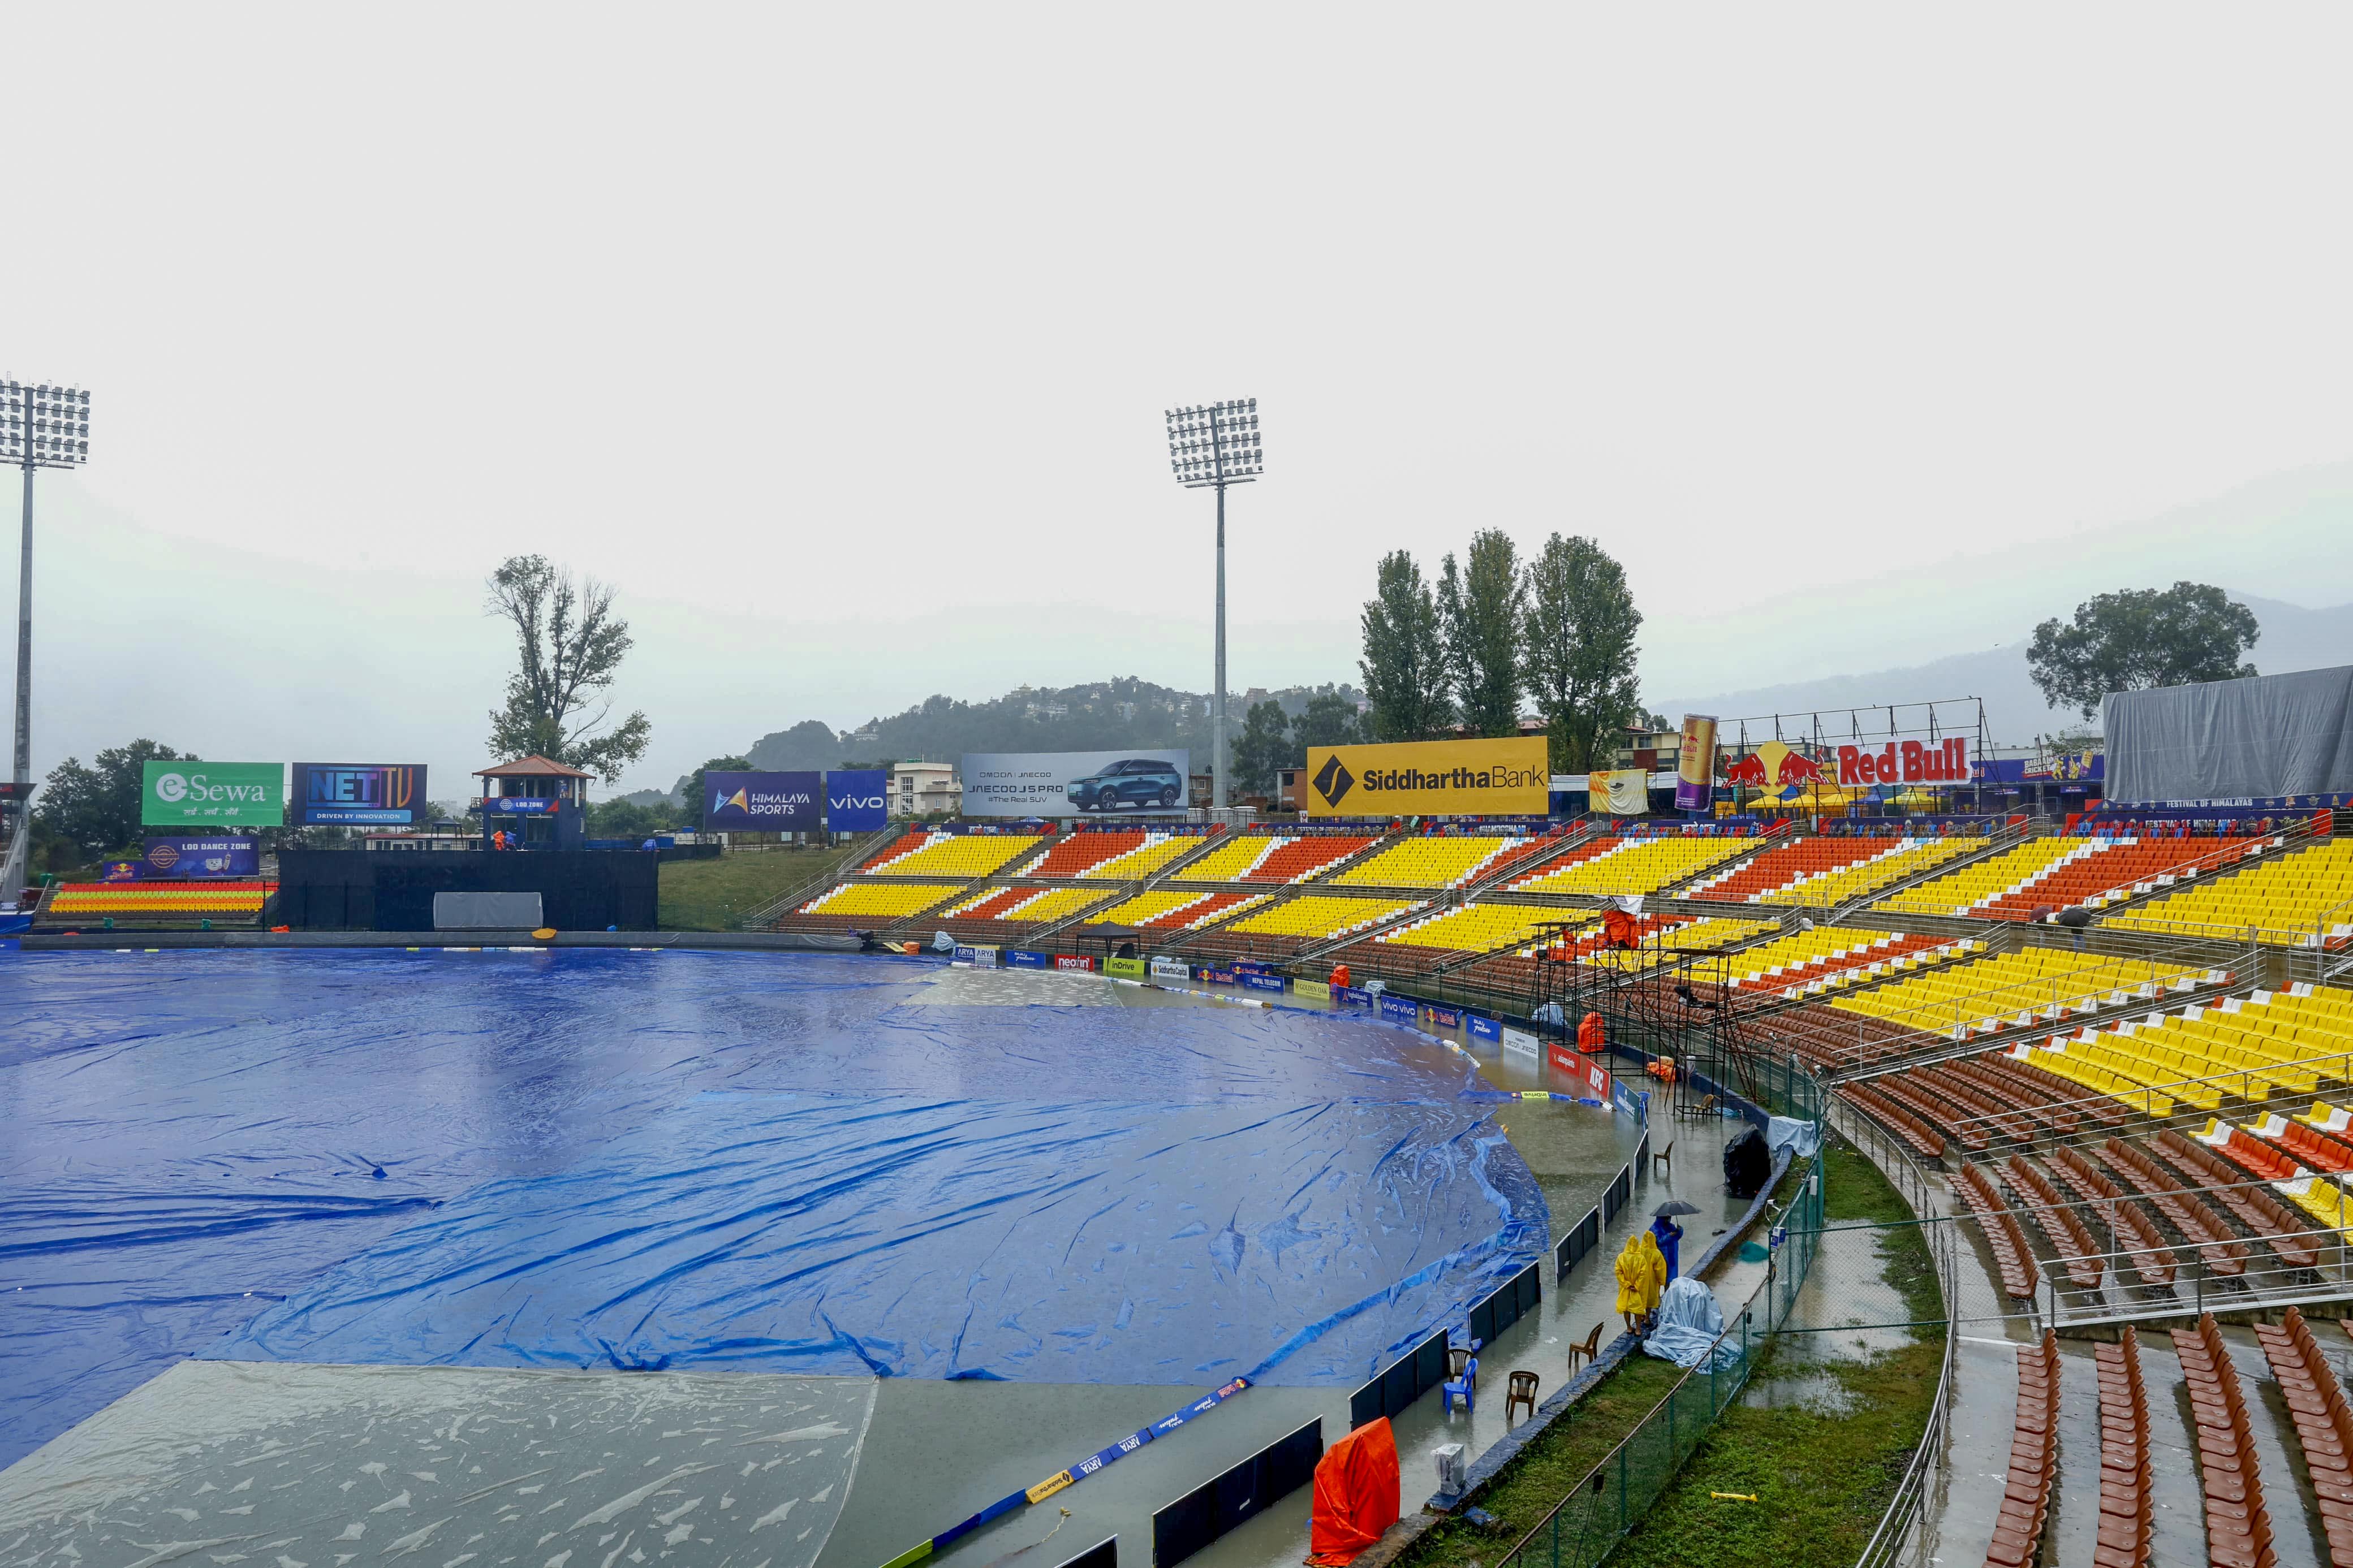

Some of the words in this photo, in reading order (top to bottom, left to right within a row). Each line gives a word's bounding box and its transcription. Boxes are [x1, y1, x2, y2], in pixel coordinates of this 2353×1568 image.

[1838, 742, 1898, 784] Red
[1901, 737, 1968, 781] Bull
[752, 793, 810, 804] HIMALAYA
[830, 794, 884, 809] vivo
[2212, 798, 2252, 807] HIMALAYAS
[750, 805, 795, 814] SPORTS
[1112, 961, 1135, 970] inDrive
[1299, 984, 1317, 992] GOLDEN
[1382, 1001, 1398, 1012] vivo
[1399, 1004, 1415, 1016] vivo
[1589, 1066, 1604, 1091] KFC
[1119, 1436, 1140, 1452] ARYA
[1080, 1457, 1102, 1474] ARYA
